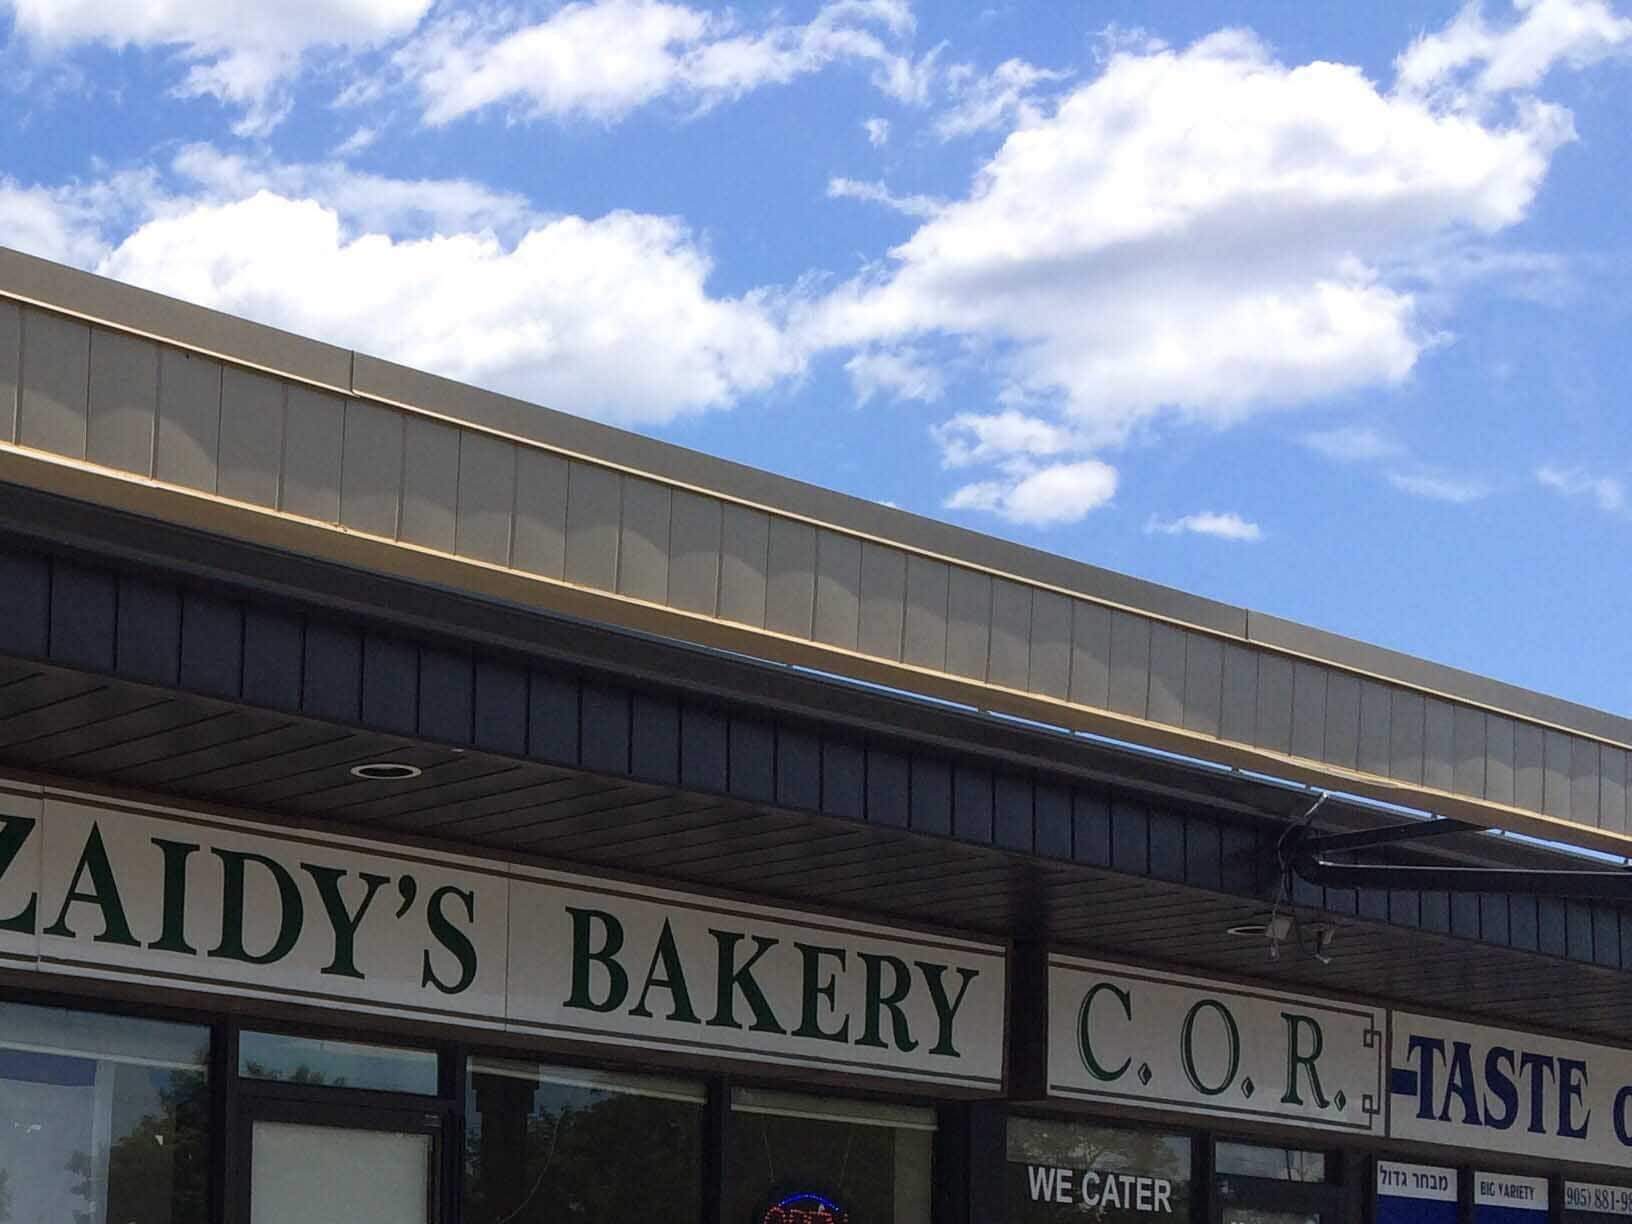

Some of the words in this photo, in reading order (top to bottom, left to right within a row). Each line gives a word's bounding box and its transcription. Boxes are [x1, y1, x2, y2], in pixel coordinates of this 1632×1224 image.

[563, 905, 980, 1058] BAKERY
[1406, 1035, 1591, 1139] TASTE
[1028, 1166, 1074, 1205] WE
[1082, 1171, 1172, 1213] CATER
[1380, 1164, 1408, 1187] גדול
[1498, 1183, 1536, 1201] VARIETY
